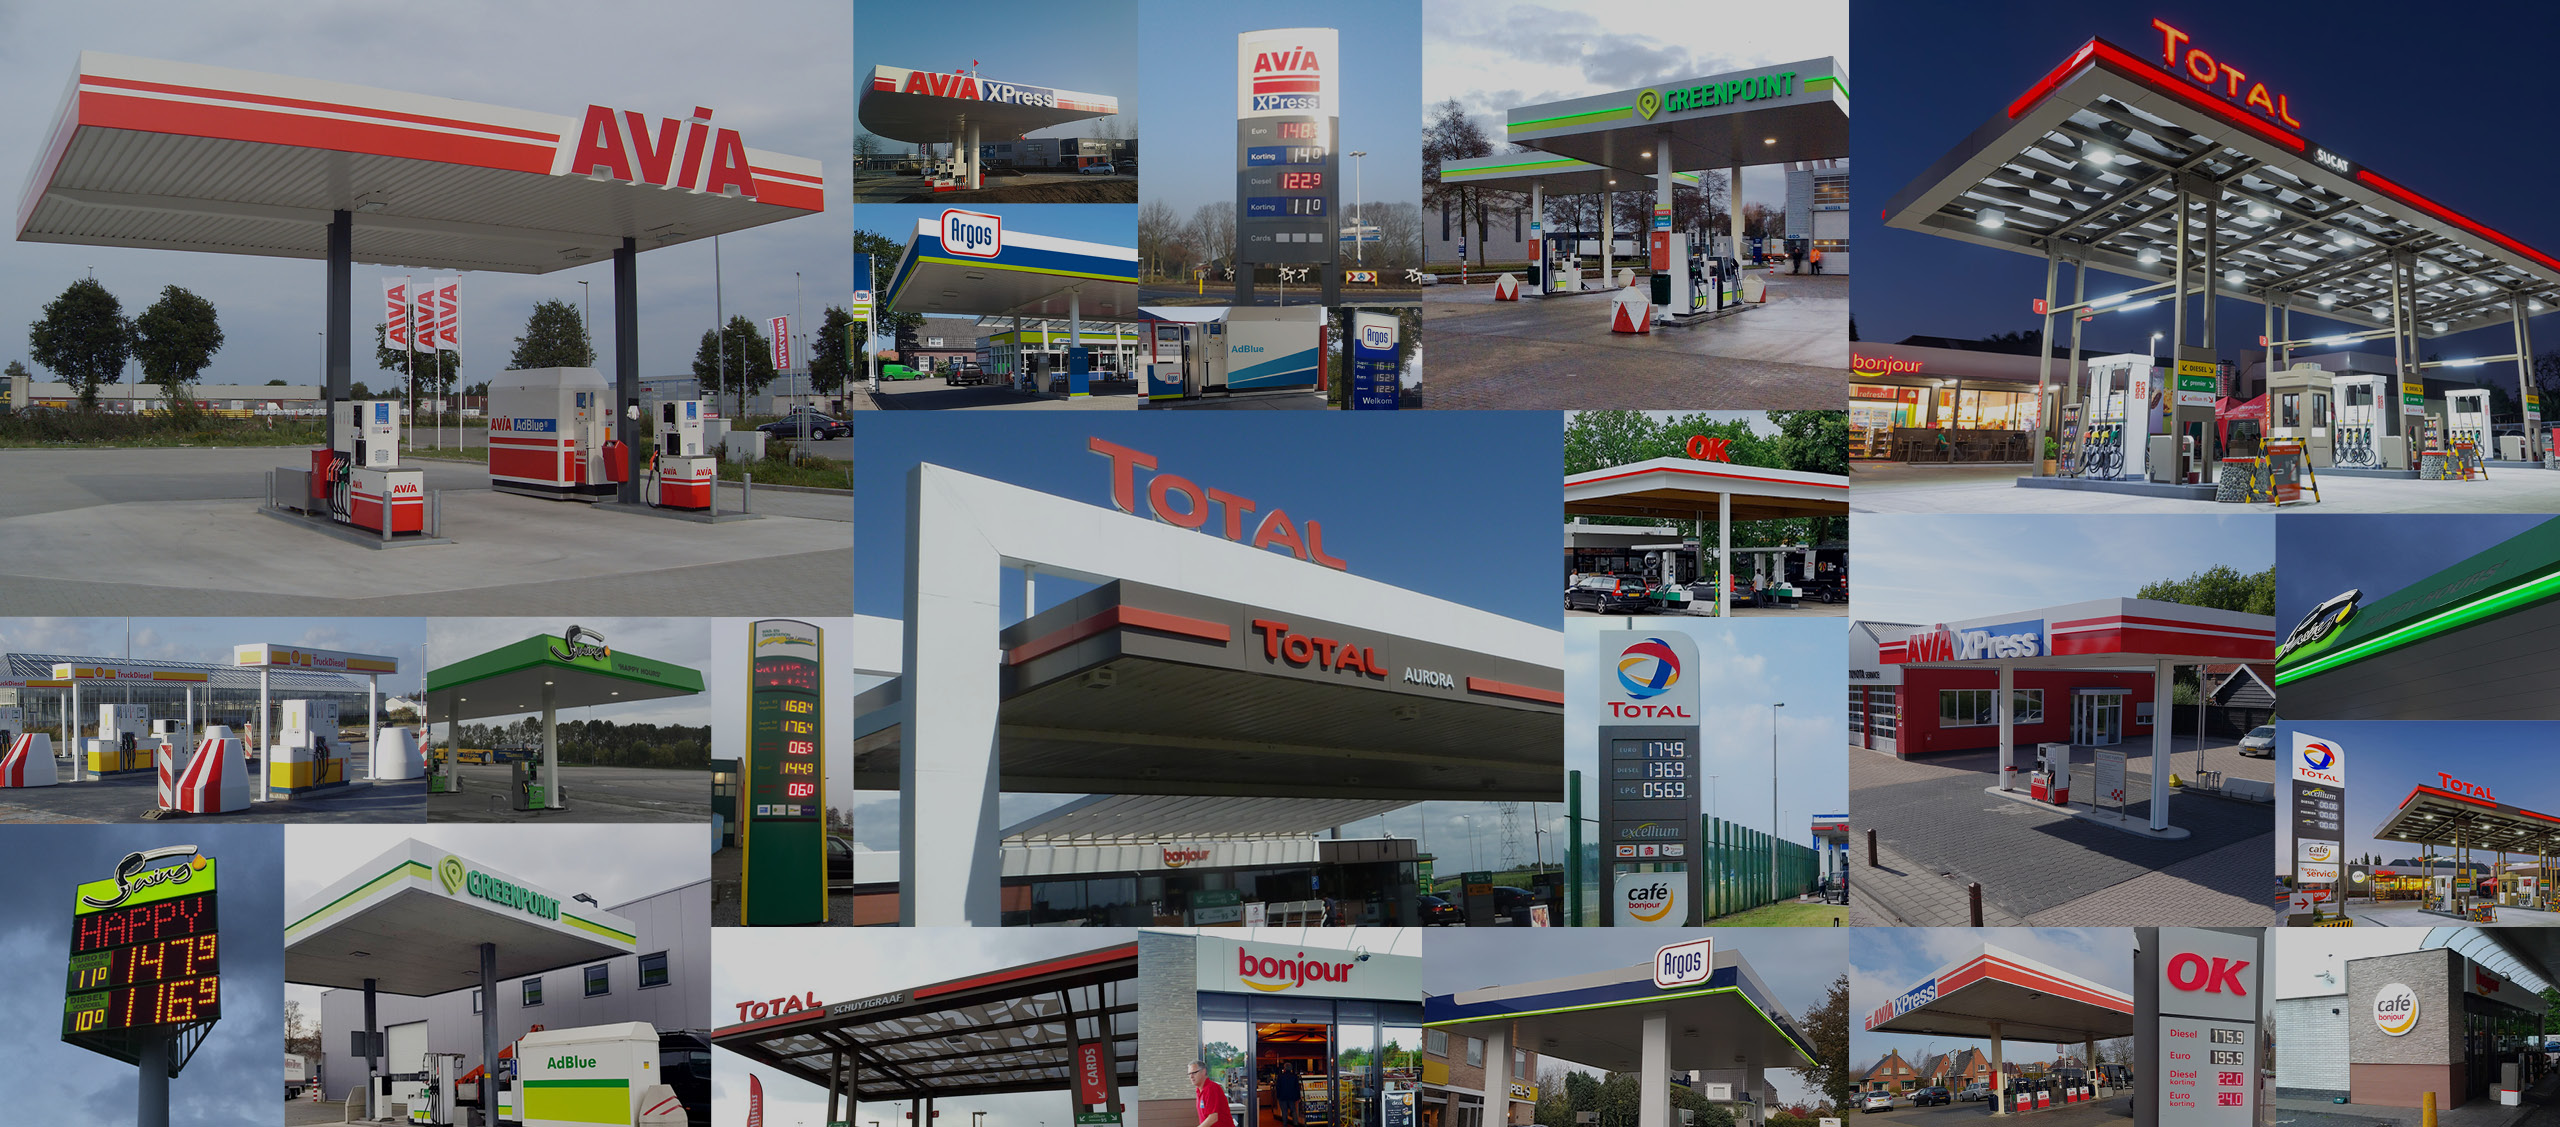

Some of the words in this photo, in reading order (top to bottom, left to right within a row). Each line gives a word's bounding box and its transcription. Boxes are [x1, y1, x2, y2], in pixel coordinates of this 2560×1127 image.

[2151, 17, 2301, 130] TOTAL
[985, 82, 1054, 107] XPress
[1663, 71, 1796, 113] GREENPOINT
[1256, 95, 1318, 110] XPress
[1251, 127, 1268, 135] Euro
[1251, 152, 1276, 161] Korting
[2315, 148, 2349, 172] SUCAT
[1251, 177, 1272, 185] Diesel
[1251, 203, 1276, 212] Korting
[951, 217, 992, 249] Argos
[1251, 233, 1272, 243] Cards
[2038, 302, 2043, 312] 1
[1367, 328, 1389, 346] Argos
[1231, 344, 1265, 353] AdBlue
[1852, 353, 1923, 376] bonjour
[2189, 365, 2208, 373] DIESEL
[2189, 380, 2207, 388] premier
[1362, 396, 1393, 405] Welkom
[1859, 390, 1888, 399] refresh!
[1686, 434, 1732, 462] OK
[1088, 436, 1347, 571] TOTAL
[1252, 619, 1389, 678] TOTAL
[1959, 630, 2040, 660] XPress
[313, 656, 345, 668] TruckDiesel
[117, 670, 152, 679] TruckDiesel
[1403, 666, 1455, 689] AURORA
[1607, 702, 1691, 718] TOTAL
[2298, 767, 2340, 783] TOTAL
[1620, 786, 1637, 794] LPG
[2302, 788, 2337, 800] excellium
[2437, 771, 2496, 801] TOTAL
[1621, 822, 1680, 839] excellium
[1163, 847, 1211, 865] bonjour
[2308, 845, 2328, 854] café
[82, 844, 198, 908] Swing
[467, 869, 562, 921] GREENPOINT
[1628, 882, 1668, 901] café
[2313, 891, 2327, 899] OPEN
[1628, 901, 1661, 910] bonjour
[79, 896, 203, 951] HAPPY
[72, 954, 98, 964] EURO
[99, 952, 110, 961] 95
[76, 960, 105, 970] VOORDEEL
[1663, 950, 1702, 979] Argos
[1239, 946, 1354, 988] bonjour
[2166, 952, 2250, 996] OK
[69, 993, 105, 1005] DIESEL
[72, 1001, 102, 1010] VOORDEEL
[735, 991, 823, 1023] TOTAL
[833, 993, 903, 1015] SCHUYTGRAAF
[1896, 985, 1935, 1016] XPress
[2377, 993, 2411, 1013] café
[2378, 1013, 2405, 1023] bonjour
[2169, 1029, 2198, 1039] Diesel
[2213, 1029, 2244, 1044] 175.9
[547, 1054, 597, 1070] AdBlue
[2169, 1051, 2191, 1060] Euro
[2213, 1051, 2243, 1065] 195.9
[1084, 1048, 1099, 1086] CARDS
[2169, 1070, 2198, 1079] Diesel
[2218, 1072, 2243, 1086] 22.0
[2169, 1078, 2196, 1087] korting
[2169, 1091, 2191, 1100] Euro
[2217, 1092, 2243, 1106] 24.0
[2169, 1100, 2196, 1109] korting
